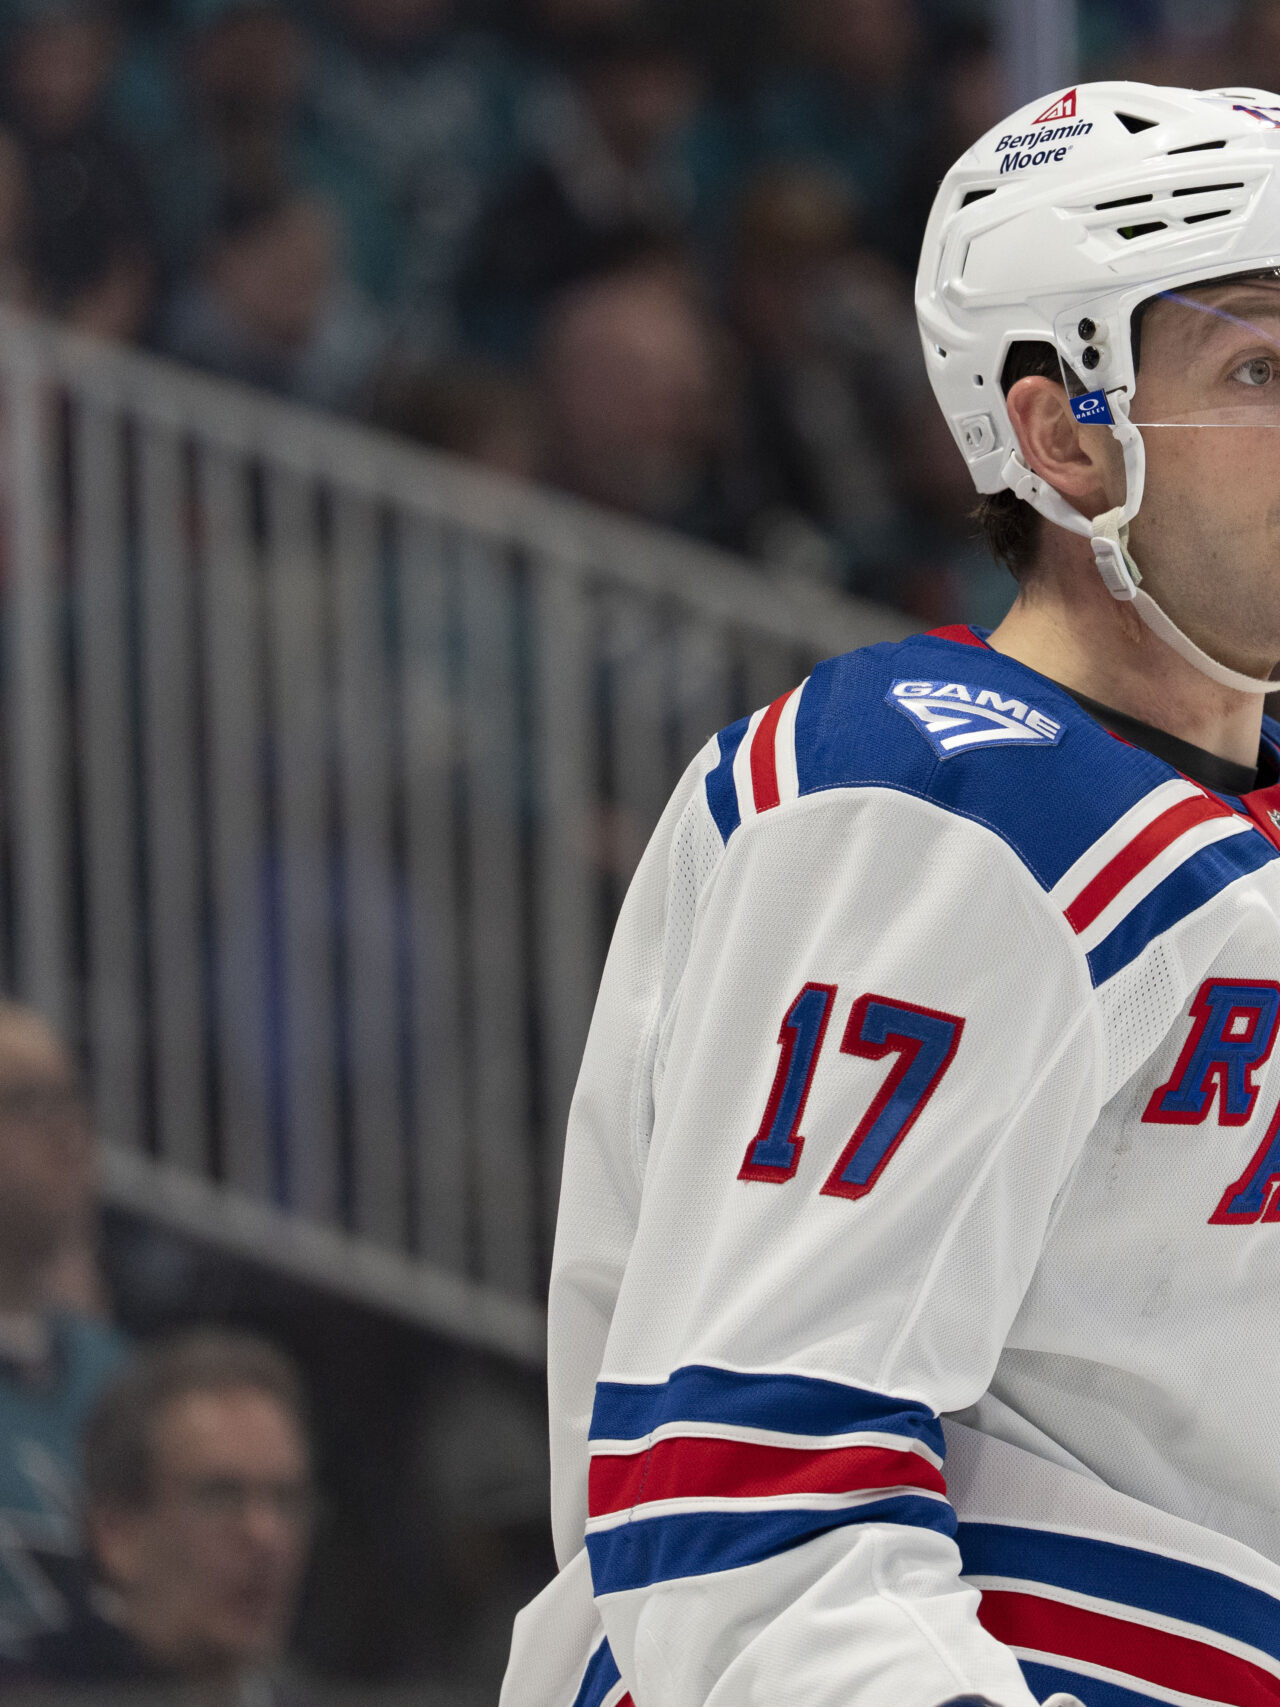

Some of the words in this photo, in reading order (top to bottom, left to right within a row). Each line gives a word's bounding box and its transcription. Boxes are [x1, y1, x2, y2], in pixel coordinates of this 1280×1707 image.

[995, 119, 1093, 152] Benjamin
[1000, 147, 1068, 174] Moore
[1076, 406, 1105, 420] OAKLEY
[893, 682, 1061, 740] GAME
[737, 981, 966, 1201] 17
